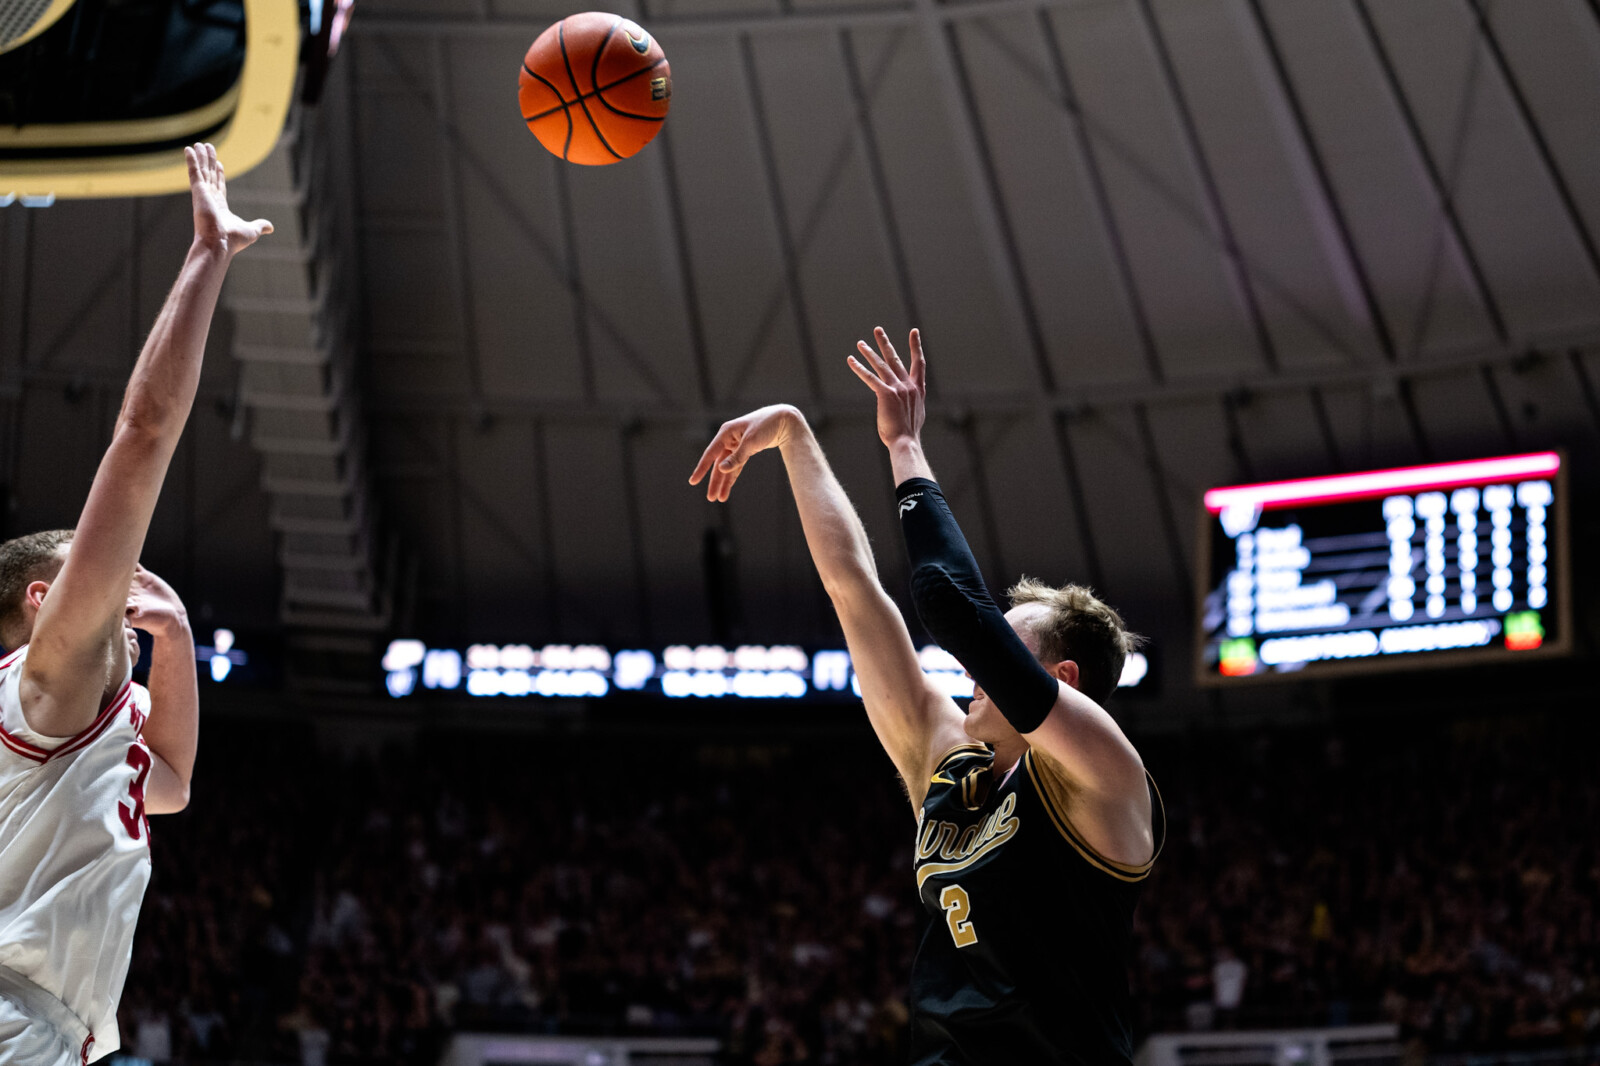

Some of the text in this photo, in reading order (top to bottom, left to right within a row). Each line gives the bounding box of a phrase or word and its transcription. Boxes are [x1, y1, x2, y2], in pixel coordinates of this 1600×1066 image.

[118, 743, 149, 842] 3
[914, 792, 1019, 865] urdue
[939, 884, 978, 948] 2
